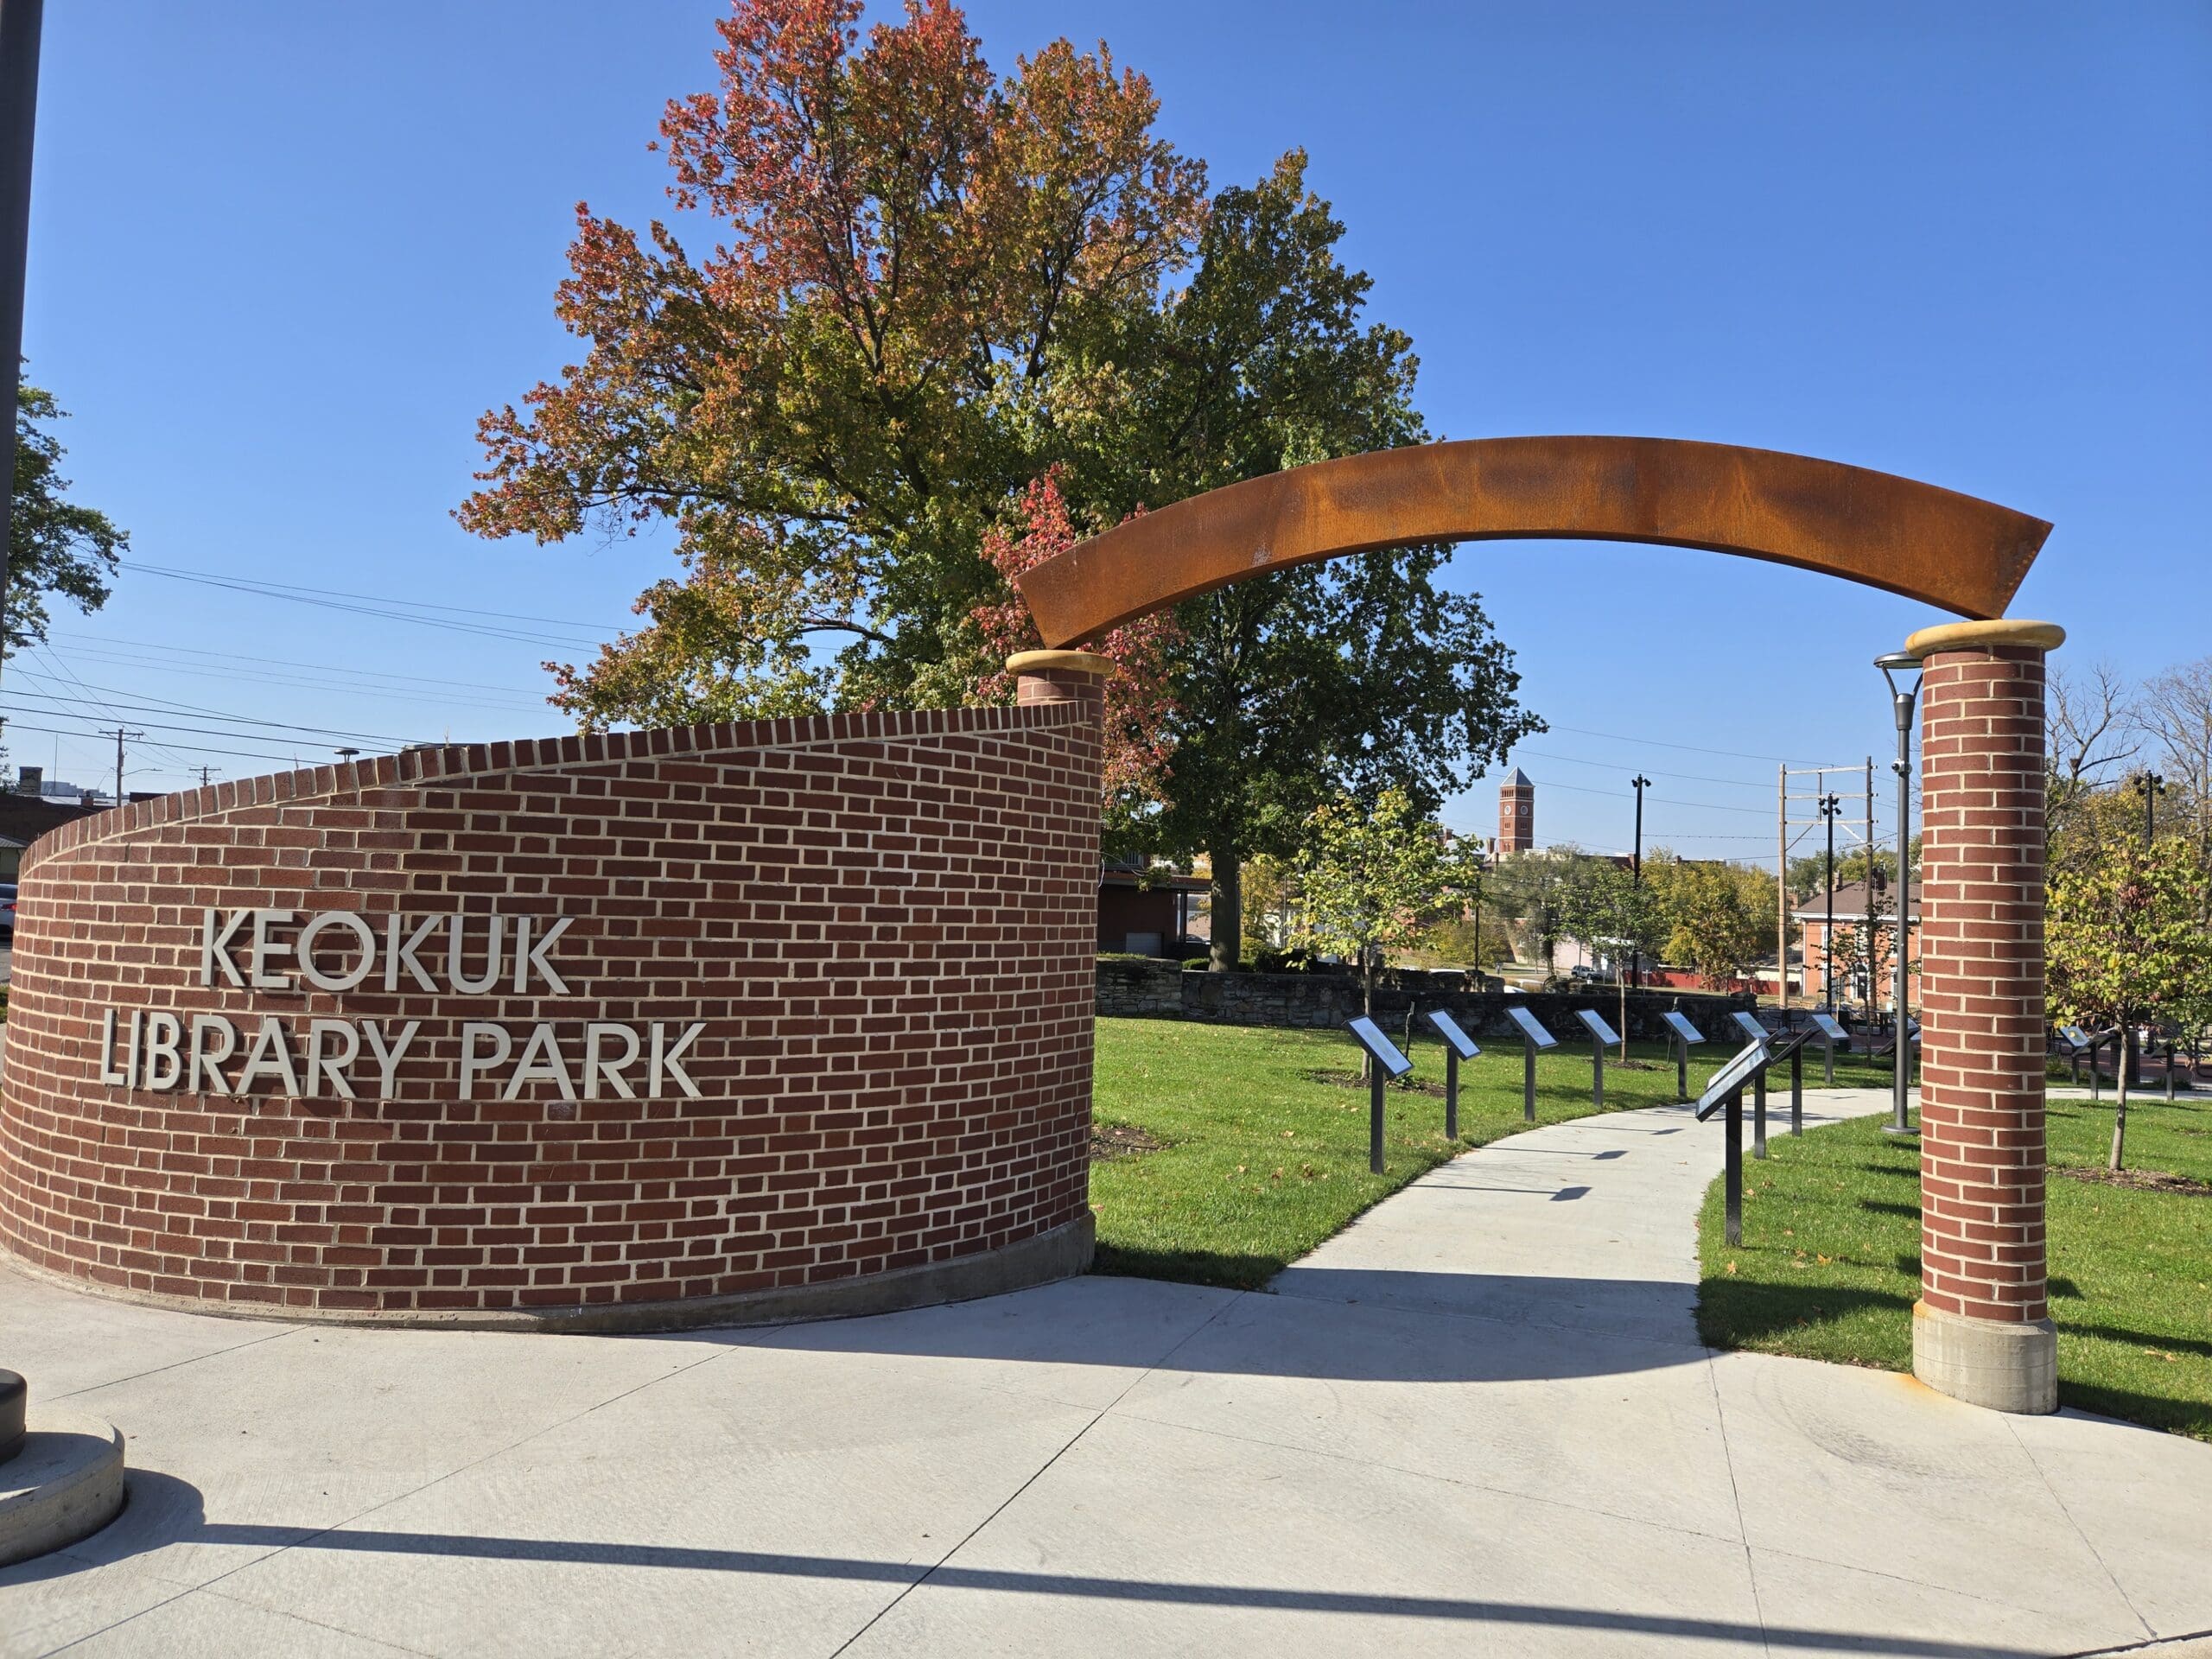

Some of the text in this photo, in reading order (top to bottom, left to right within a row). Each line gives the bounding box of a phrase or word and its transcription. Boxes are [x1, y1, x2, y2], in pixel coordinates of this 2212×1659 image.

[200, 909, 575, 994] KEOKUK
[100, 1008, 708, 1100] LIBRARY PARK
